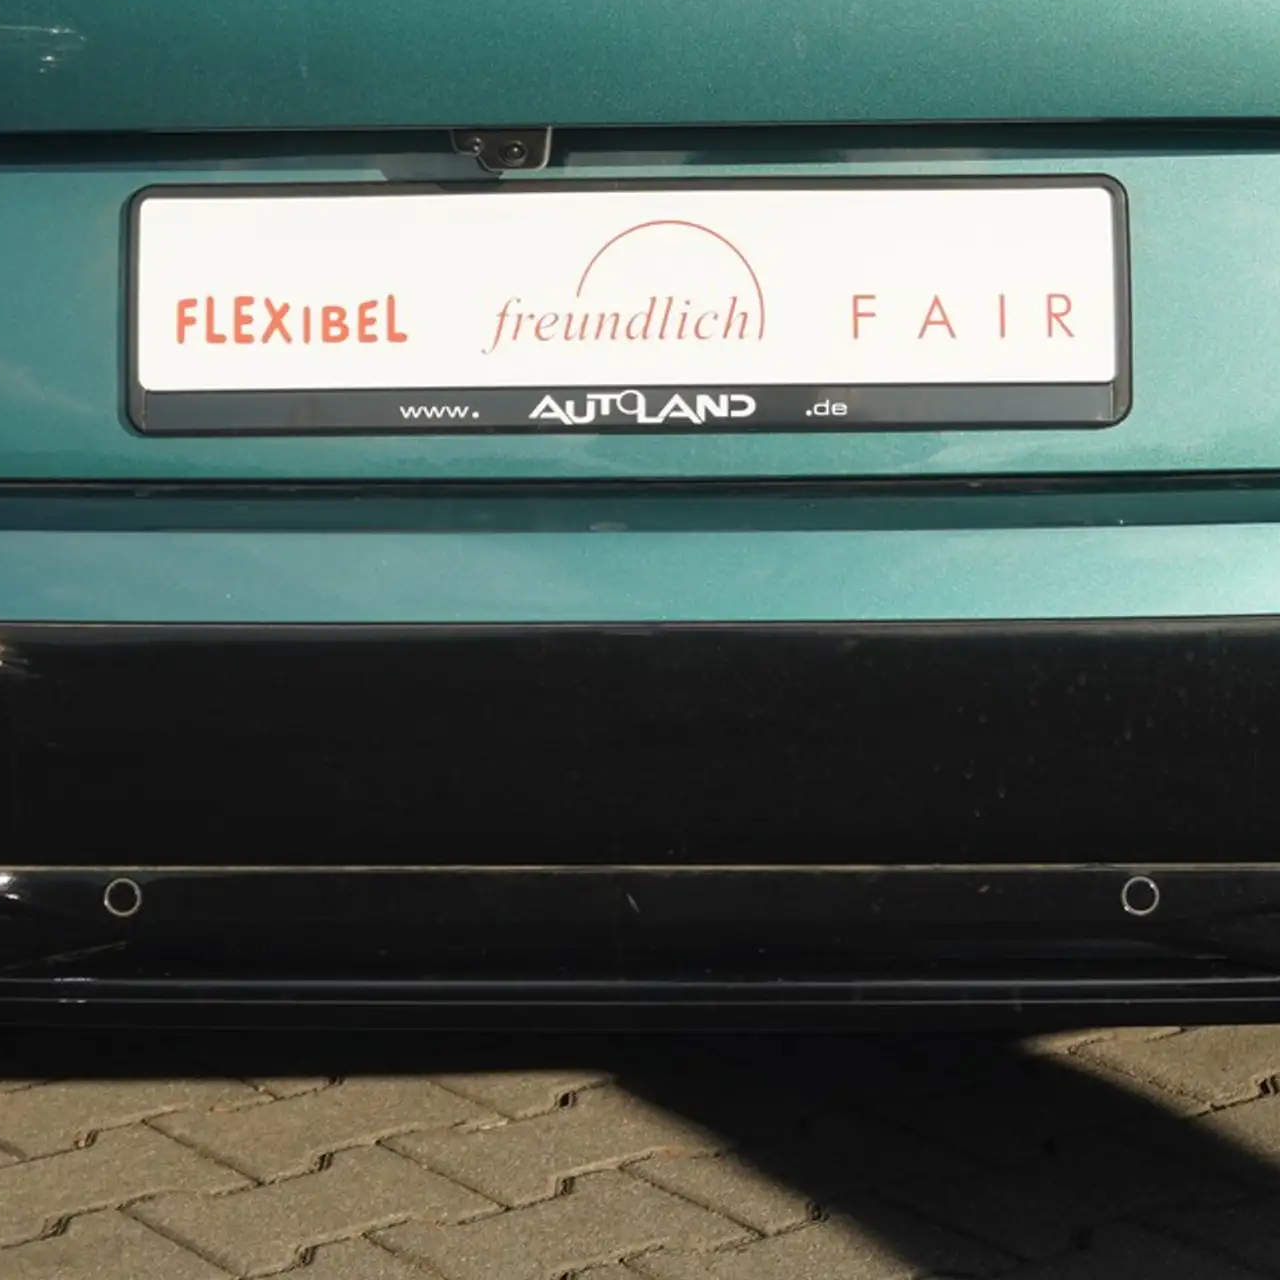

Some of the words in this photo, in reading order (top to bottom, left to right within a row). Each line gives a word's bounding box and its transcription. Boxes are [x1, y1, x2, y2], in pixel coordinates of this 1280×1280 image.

[176, 293, 408, 345] FLEXIBEL
[481, 296, 750, 355] freundlich
[851, 293, 1075, 340] FAIR
[399, 404, 480, 420] www.
[528, 389, 757, 425] AUTOLAND
[805, 400, 848, 417] .de
